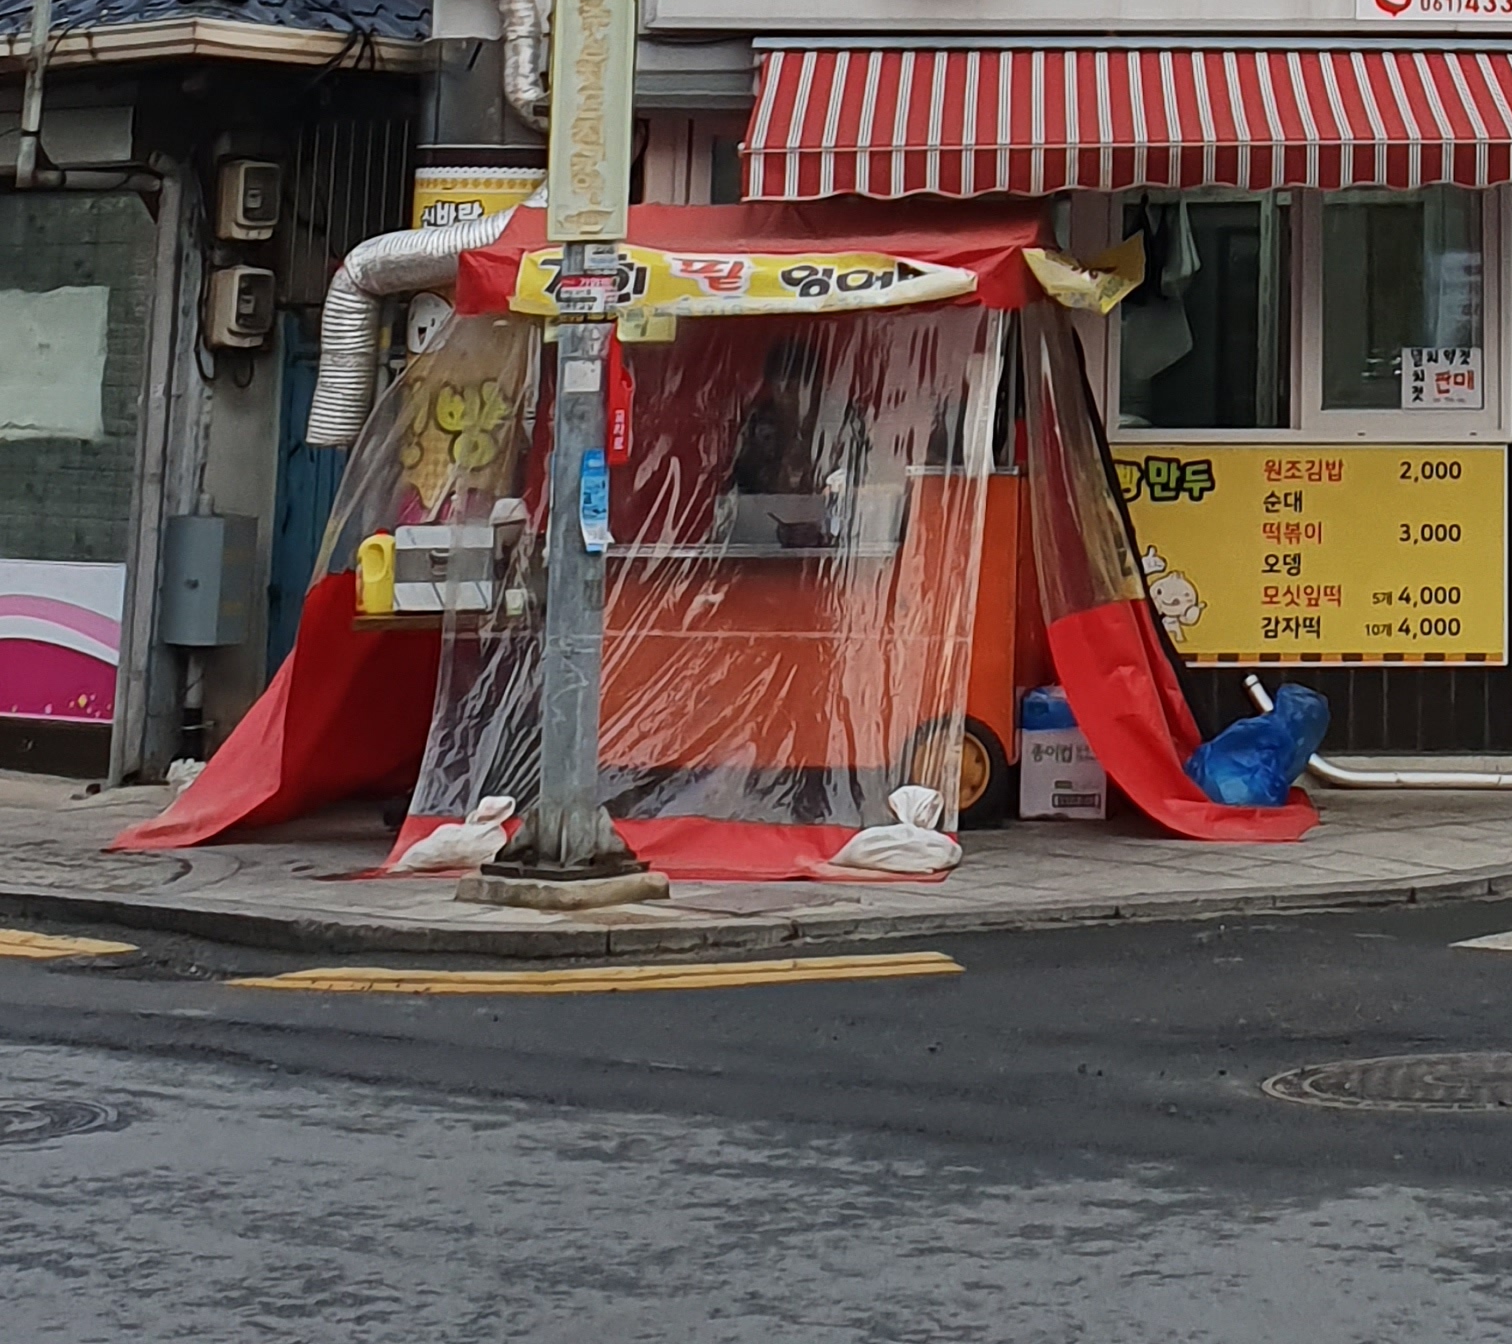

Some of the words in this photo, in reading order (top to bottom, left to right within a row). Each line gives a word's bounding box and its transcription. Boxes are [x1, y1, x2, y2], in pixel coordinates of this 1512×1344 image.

[781, 264, 926, 298] 잉어
[1435, 370, 1475, 394] 판매
[1144, 455, 1216, 503] 만두
[1263, 458, 1344, 483] 원조김밥
[1399, 461, 1462, 484] 2,000
[1263, 491, 1303, 513] 순대
[1262, 521, 1323, 545] 떡볶이
[1399, 524, 1462, 545] 3,000
[1262, 553, 1302, 576] 오뎅
[1261, 584, 1342, 608] 모싯잎떡
[1372, 591, 1393, 605] 5개
[1398, 586, 1462, 607] 4,000
[1261, 616, 1321, 640] 감자떡
[1365, 622, 1392, 637] 10개
[1398, 617, 1462, 638] 4,000
